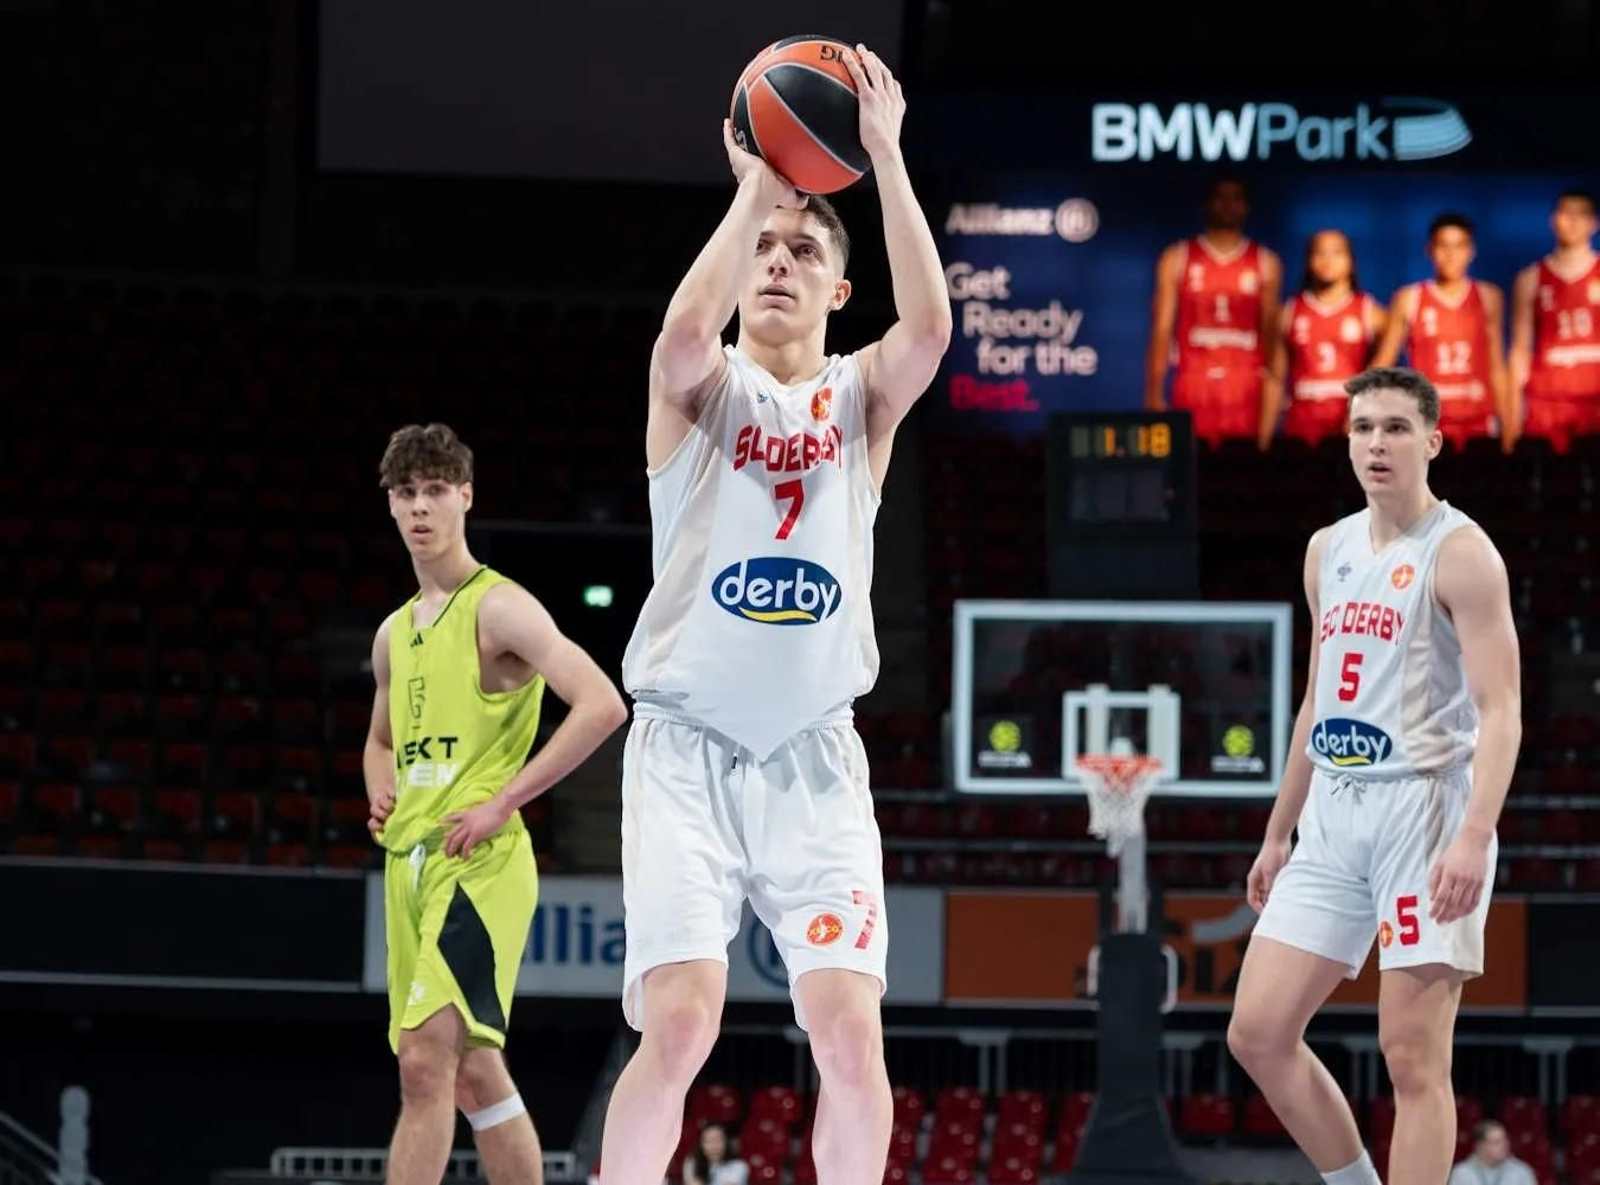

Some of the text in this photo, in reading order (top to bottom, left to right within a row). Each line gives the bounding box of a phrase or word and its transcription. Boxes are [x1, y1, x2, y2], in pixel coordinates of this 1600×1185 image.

[1091, 102, 1390, 162] BMWPark
[945, 262, 1011, 300] Get
[963, 300, 1083, 344] Ready
[977, 336, 1098, 376] for the
[1437, 340, 1472, 375] 12
[774, 479, 805, 540] 7
[719, 559, 838, 623] derby
[1341, 602, 1404, 645] DERBY
[1338, 653, 1364, 702] 5
[396, 737, 459, 769] EXT
[1314, 720, 1388, 766] derby
[852, 890, 877, 950] 7
[1397, 896, 1419, 945] 5
